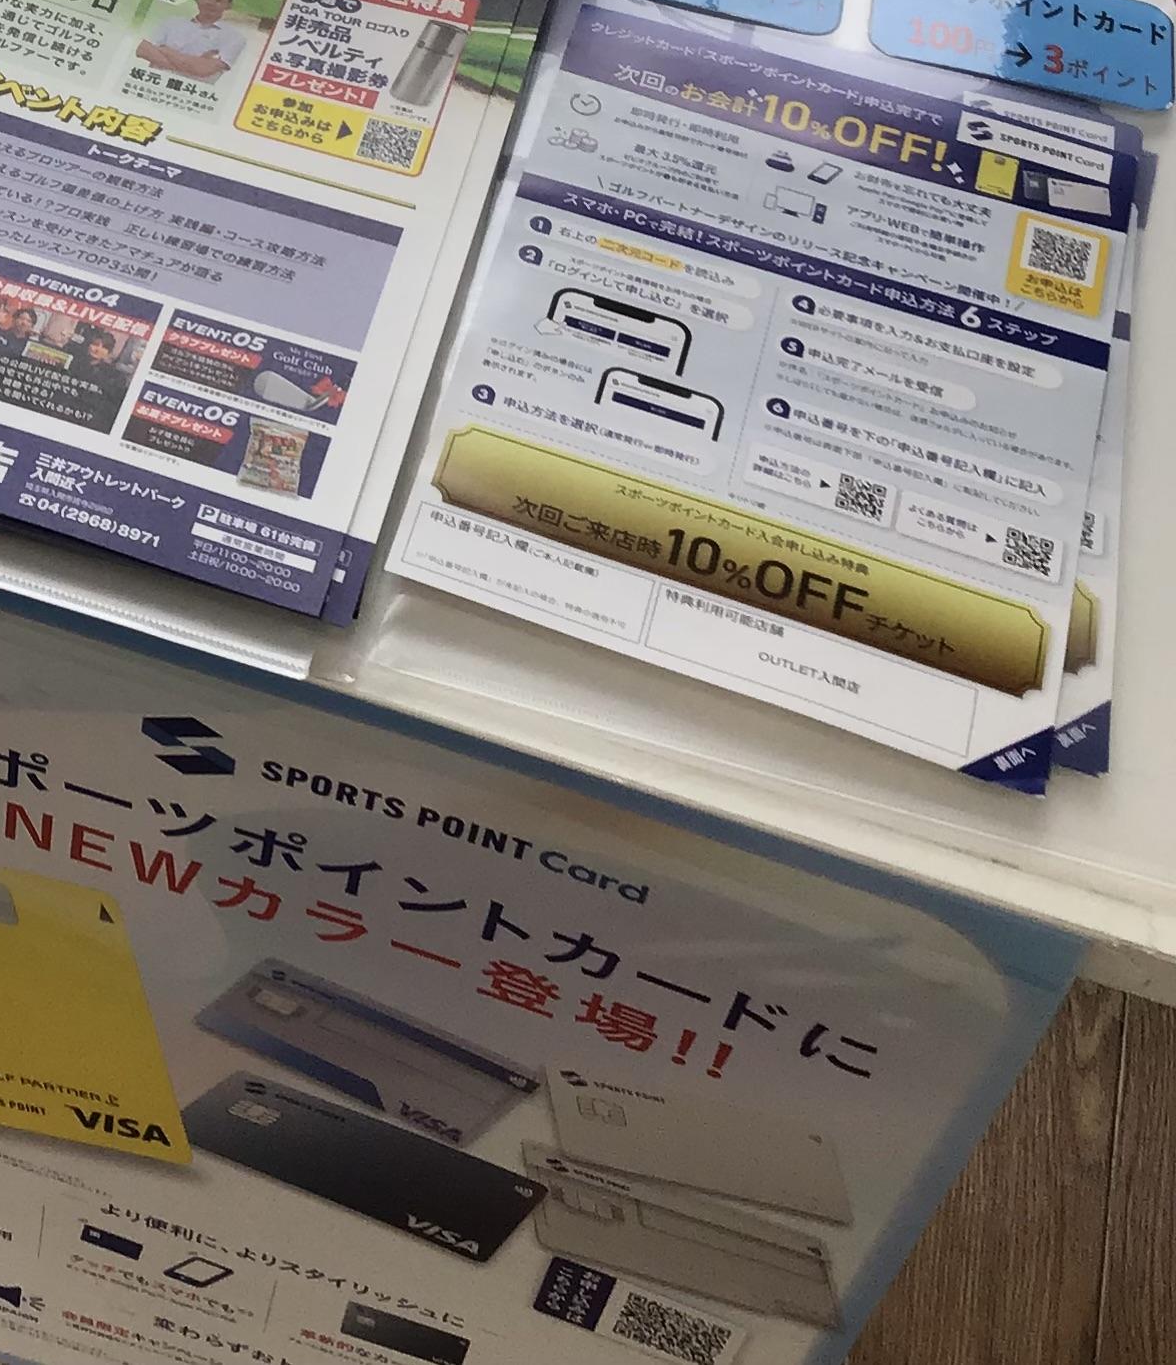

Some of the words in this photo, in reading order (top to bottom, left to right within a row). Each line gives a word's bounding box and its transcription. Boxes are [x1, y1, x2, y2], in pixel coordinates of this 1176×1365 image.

[284, 14, 352, 44] 非売品
[290, 3, 320, 17] PGA
[322, 10, 362, 28] TOUR
[365, 22, 410, 38] ロゴ入り
[278, 35, 384, 69] ノベルティ
[271, 69, 369, 105] プレゼント!
[1043, 45, 1157, 97] 3ポイント
[613, 64, 758, 117] 次回のお会計
[250, 118, 324, 145] こちらから
[253, 104, 332, 132] お申込みは
[88, 143, 182, 179] トークテーマ
[26, 274, 120, 307] EVENT.04
[173, 317, 268, 352] EVENT.05
[143, 390, 240, 427] EVENT.06
[512, 494, 663, 560] 次回ご来店時
[666, 527, 870, 622] 10%OFF
[865, 612, 956, 656] チケット
[757, 651, 861, 694] OUTLET入間店
[259, 759, 405, 823] SPORTS
[416, 802, 534, 862] POINT
[538, 849, 651, 907] Card
[64, 1104, 171, 1147] VISA
[406, 1213, 480, 1256] VISA
